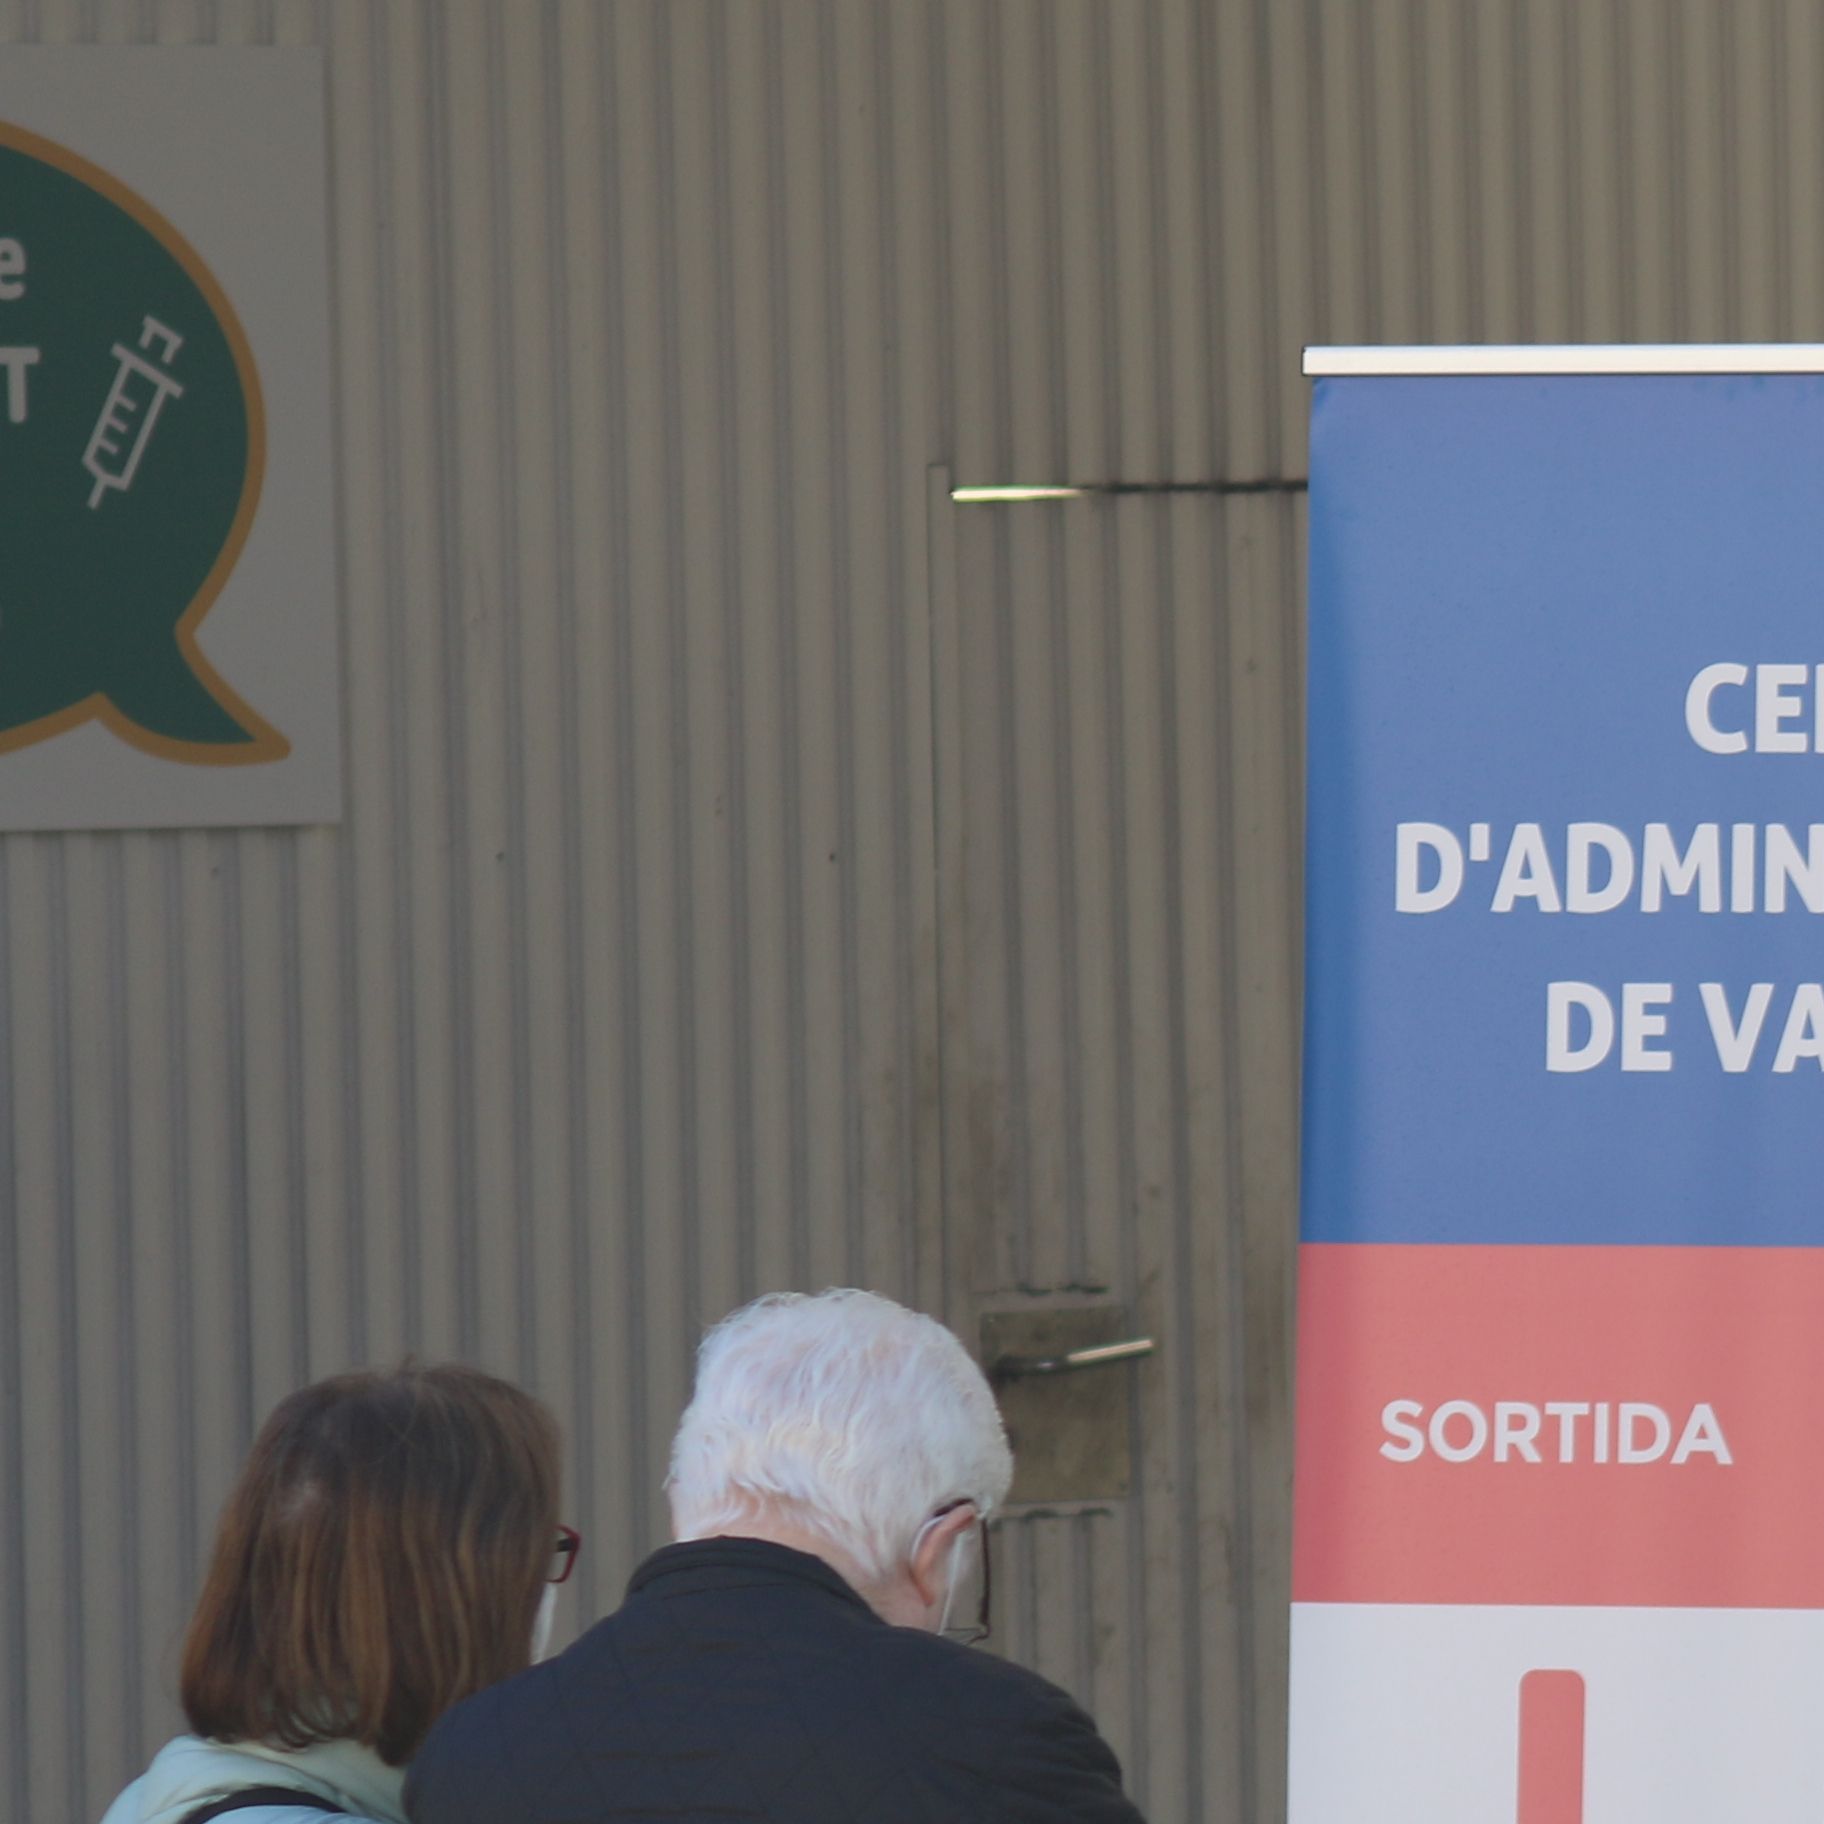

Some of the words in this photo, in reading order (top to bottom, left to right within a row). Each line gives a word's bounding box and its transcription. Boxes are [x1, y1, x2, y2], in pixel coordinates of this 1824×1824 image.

[0, 346, 41, 423] T
[1545, 980, 1674, 1074] DE
[1378, 1398, 1733, 1466] SORTIDA
